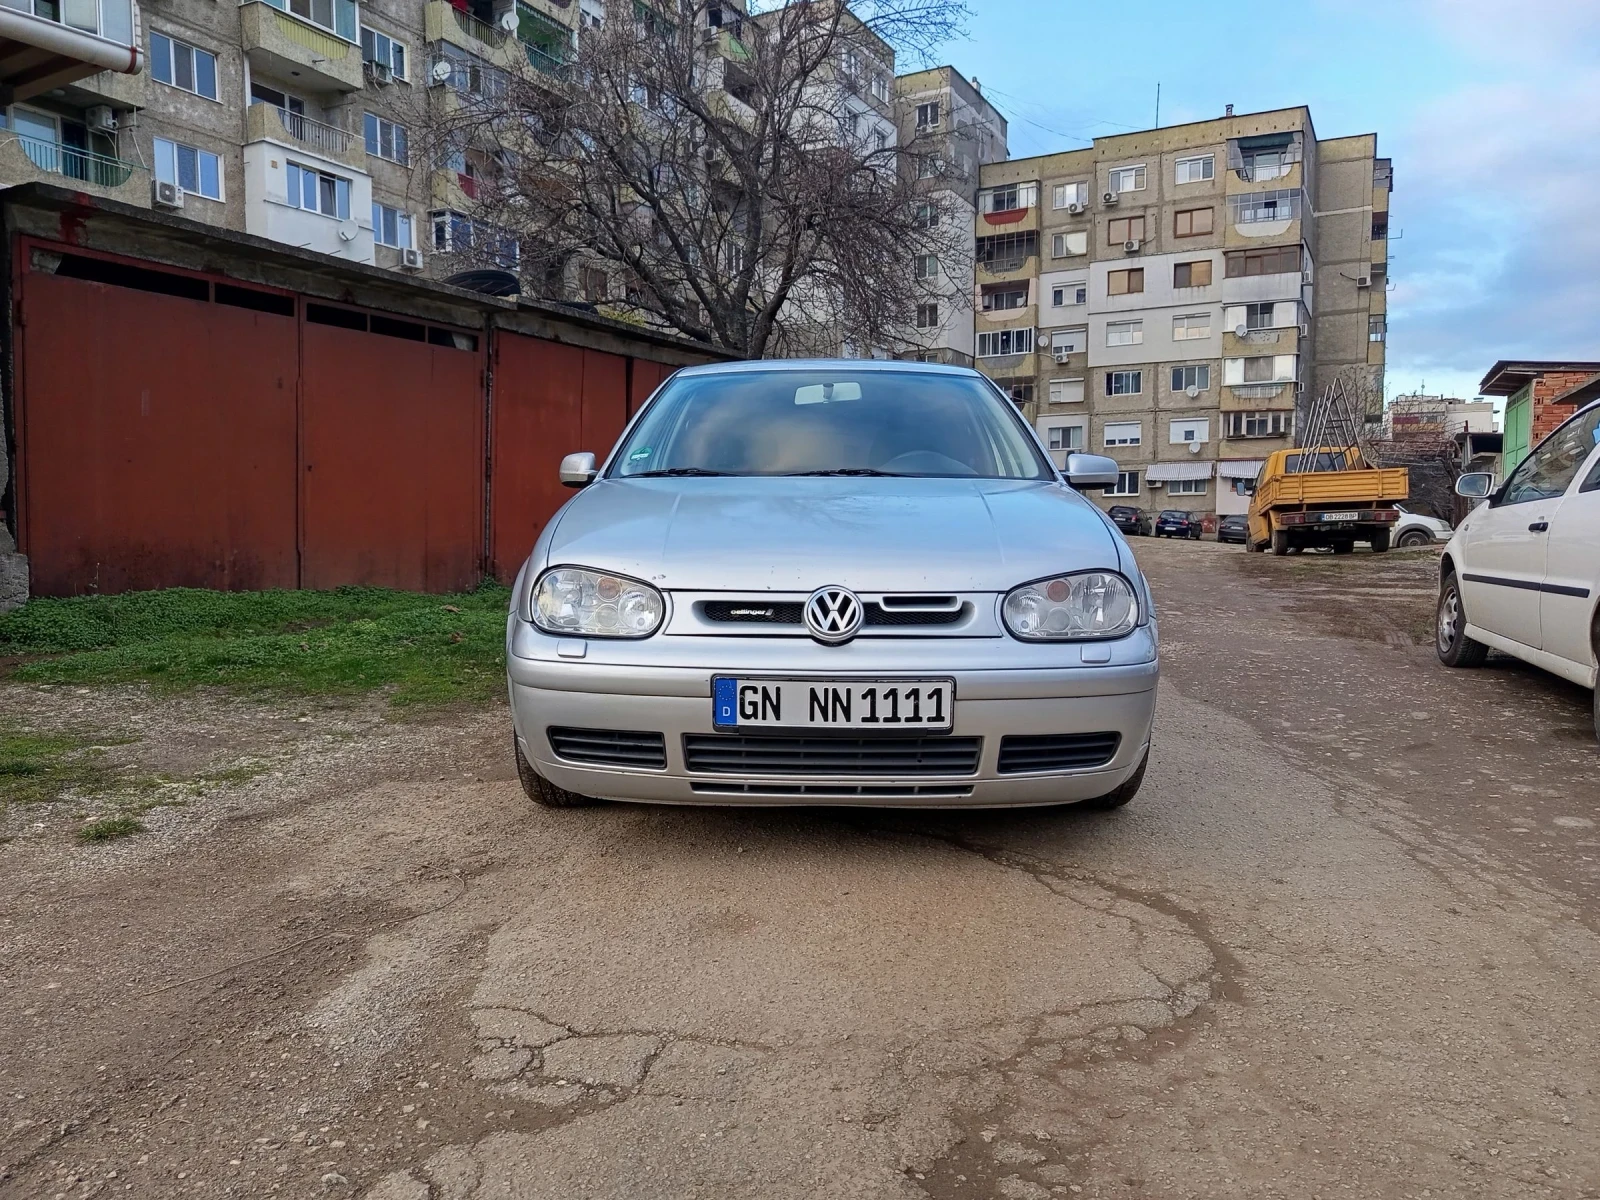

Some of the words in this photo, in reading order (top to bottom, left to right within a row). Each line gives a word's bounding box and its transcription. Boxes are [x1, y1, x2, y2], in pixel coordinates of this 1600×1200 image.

[722, 706, 731, 717] D
[738, 685, 781, 721] GN
[809, 686, 852, 723] NN
[860, 686, 946, 723] 1111
